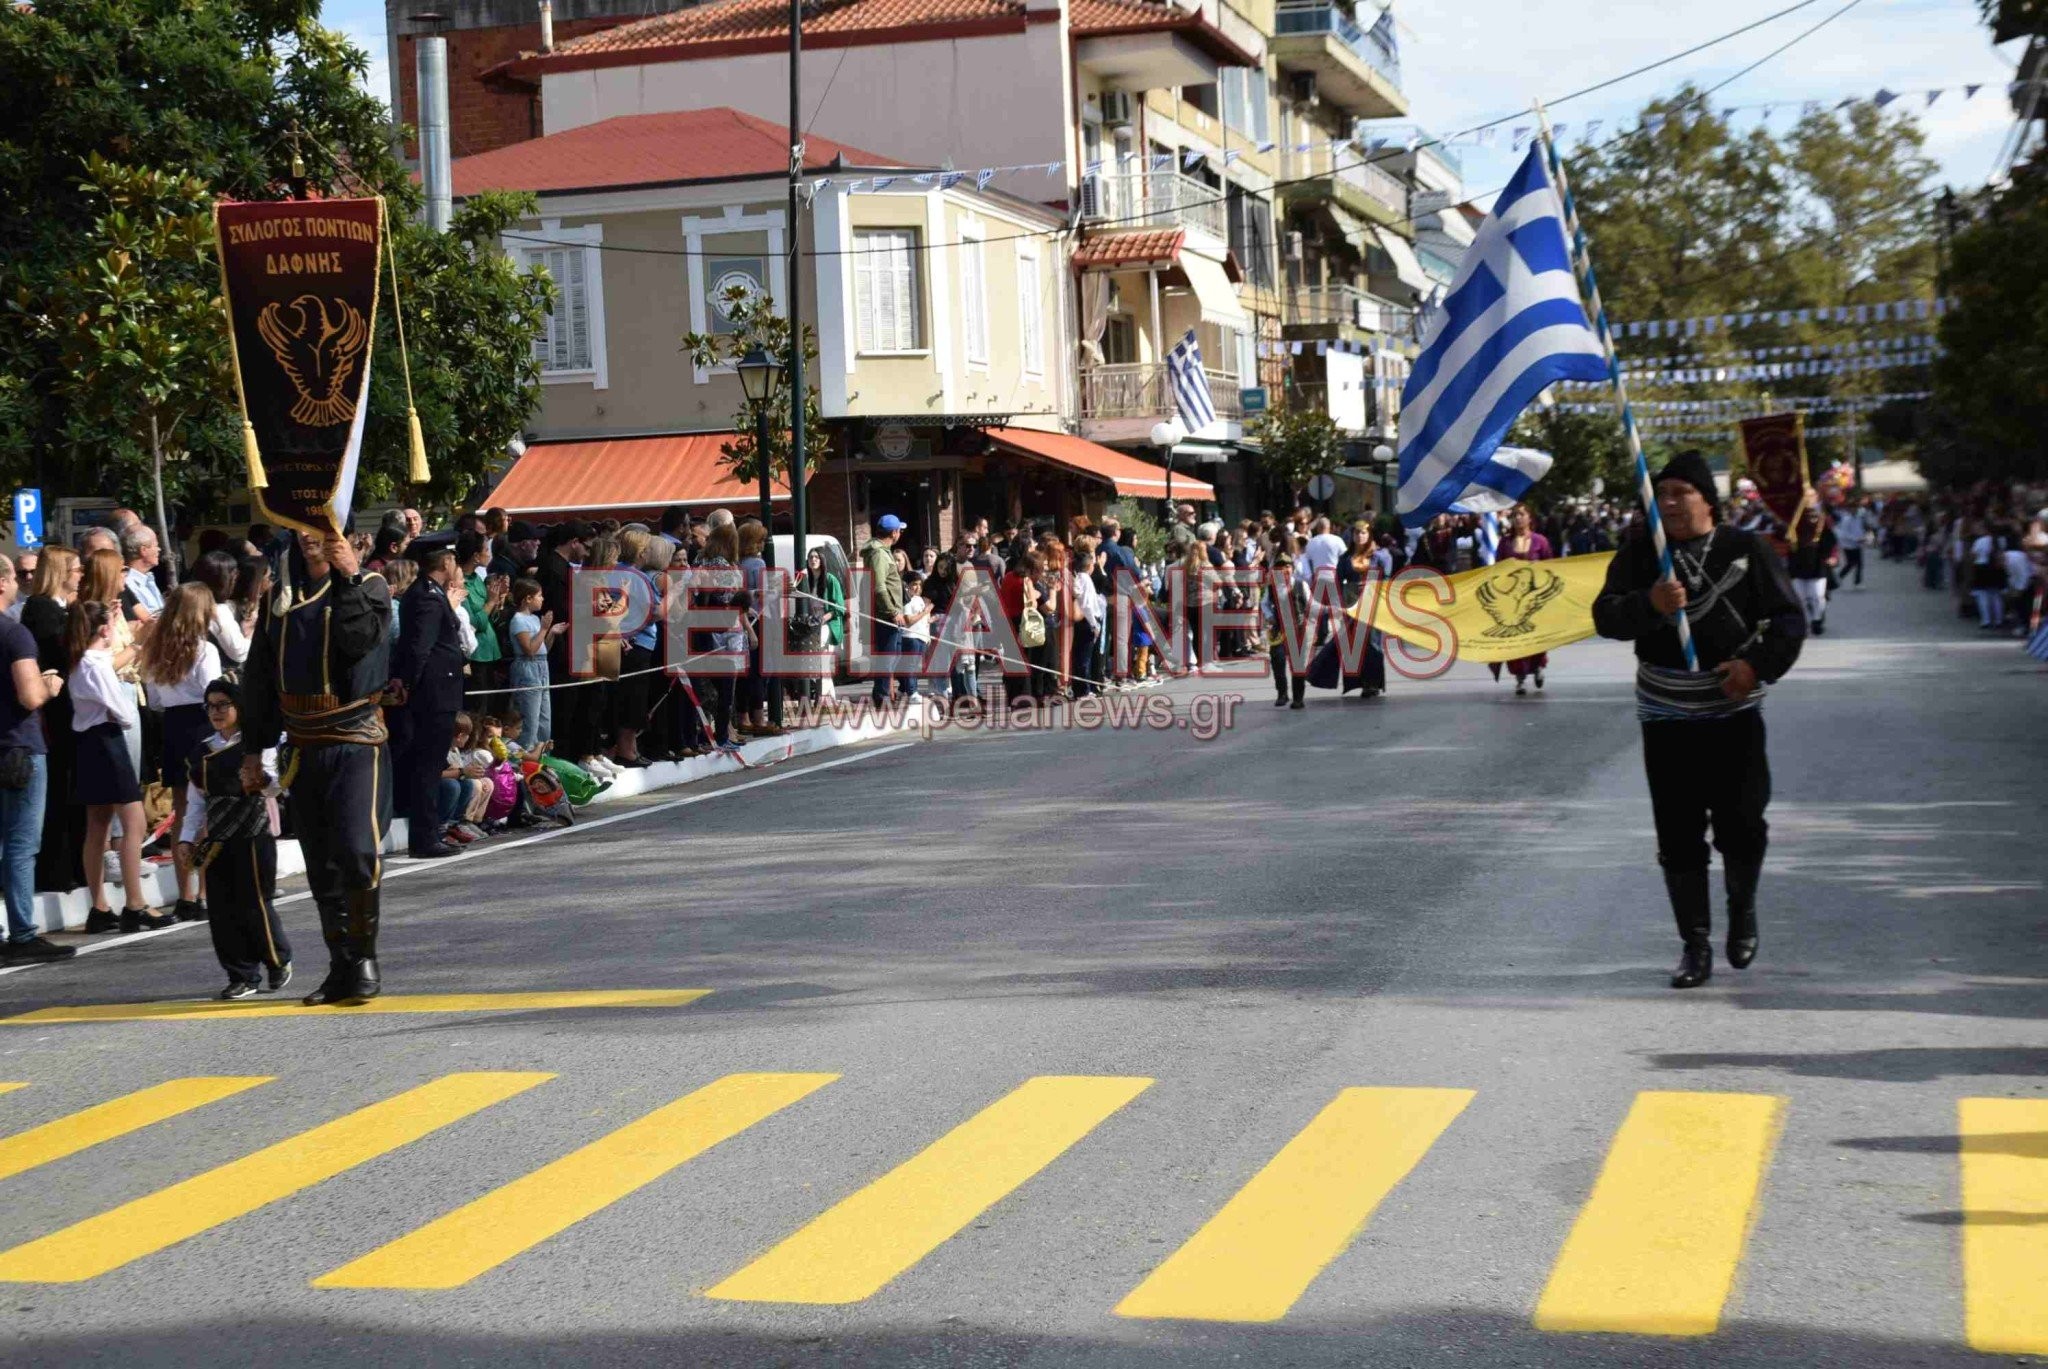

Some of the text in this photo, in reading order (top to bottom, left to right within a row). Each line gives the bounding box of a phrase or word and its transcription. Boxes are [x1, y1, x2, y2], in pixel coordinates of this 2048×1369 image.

[228, 217, 374, 245] ΣΥΛΛΟΓΟΣ ΠΟΝΤΙΩΝ
[266, 251, 343, 275] ΔΑΦΝΗΣ
[19, 493, 36, 524] P
